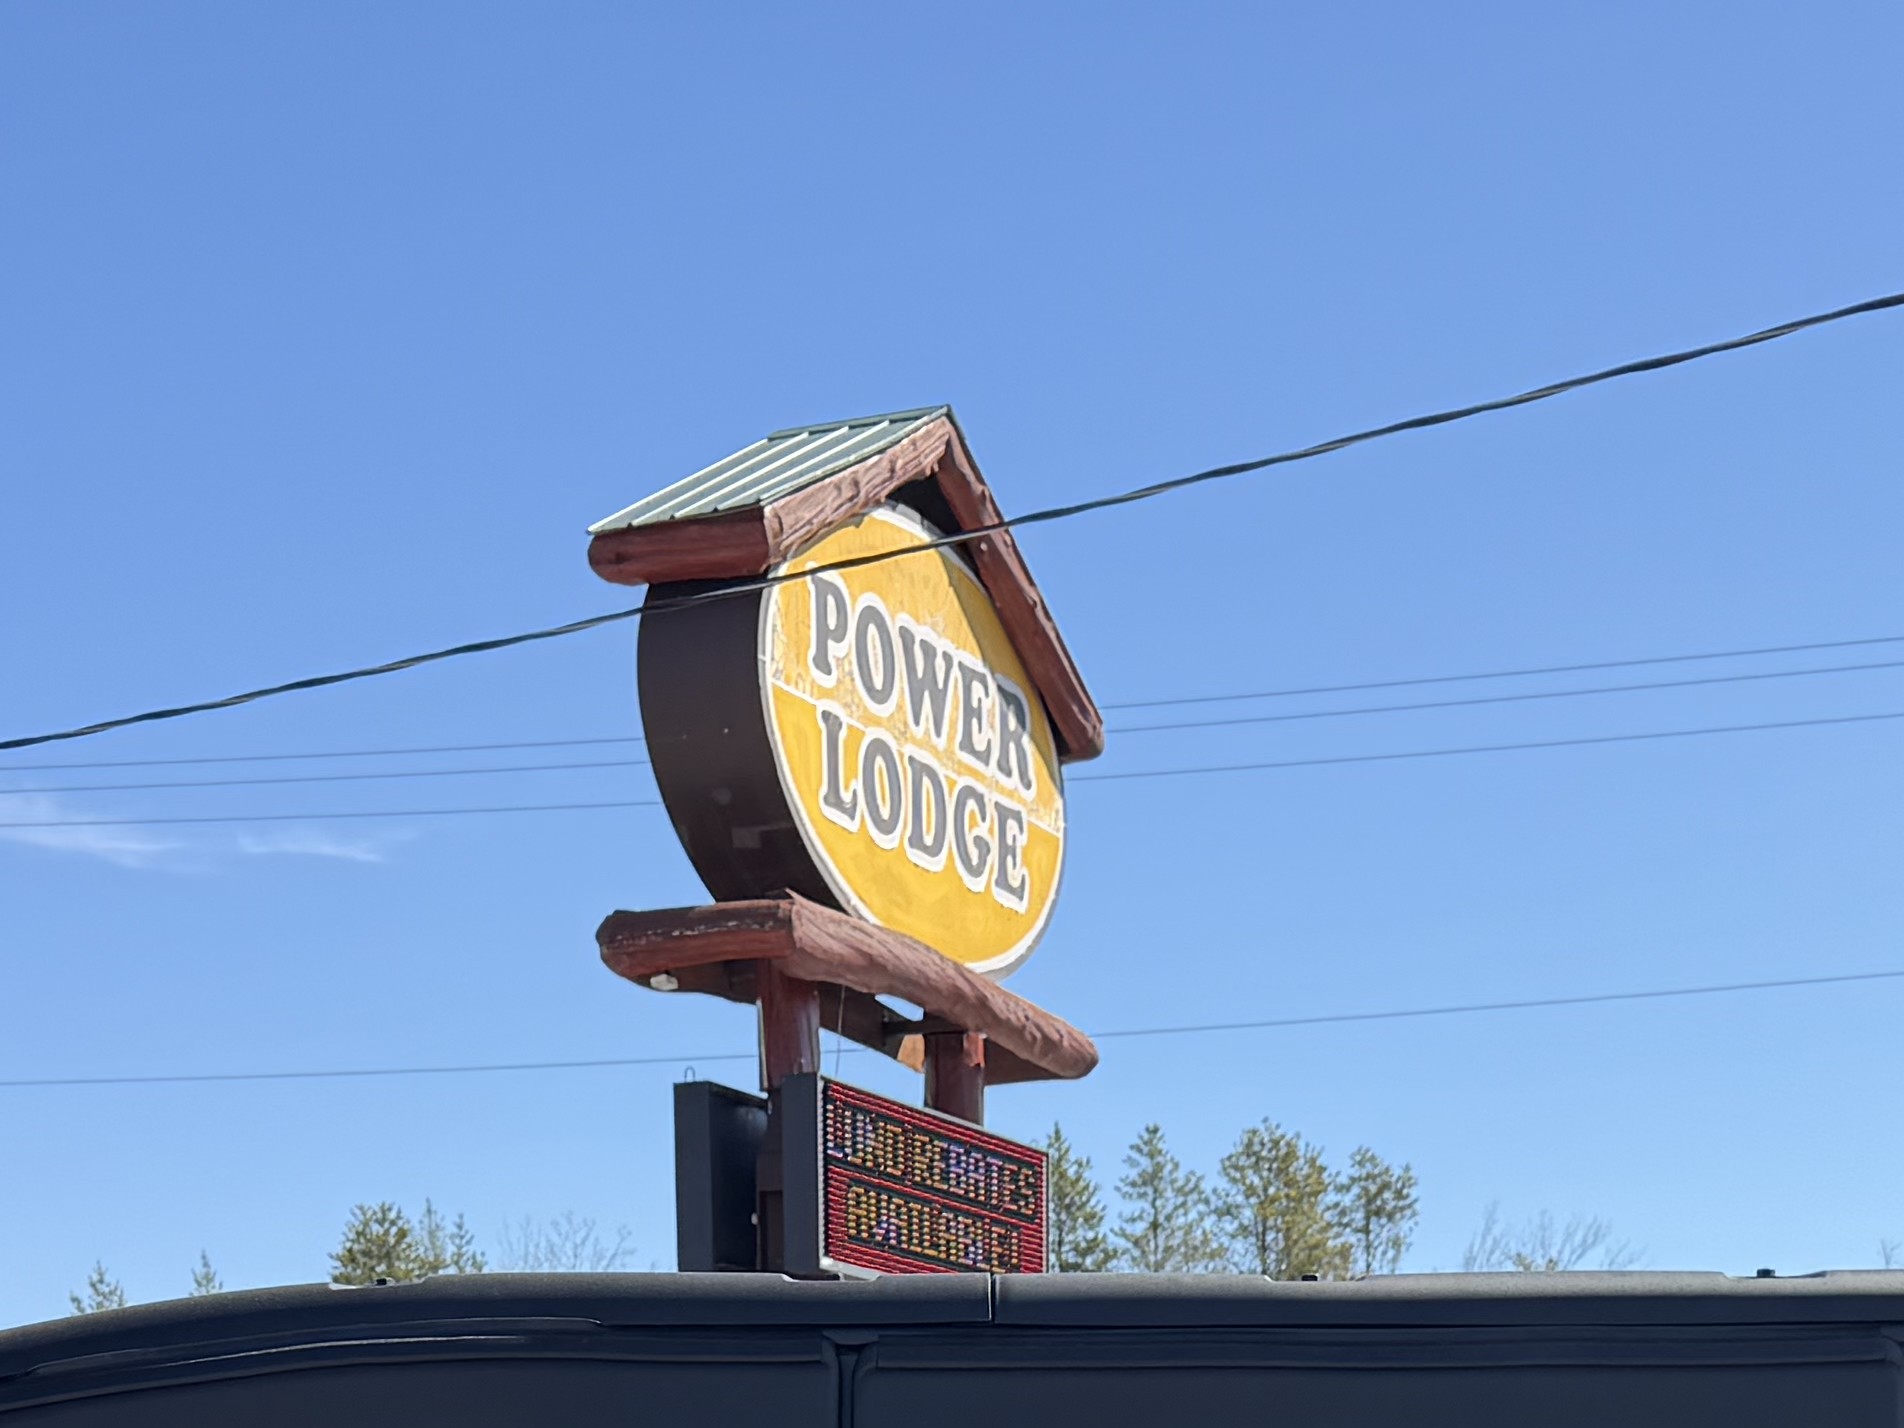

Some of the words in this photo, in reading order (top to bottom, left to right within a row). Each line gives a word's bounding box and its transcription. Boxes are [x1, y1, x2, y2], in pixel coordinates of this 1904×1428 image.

[809, 572, 1034, 793] POWER
[820, 708, 1028, 903] LODGE
[912, 1132, 1037, 1216] REBATES
